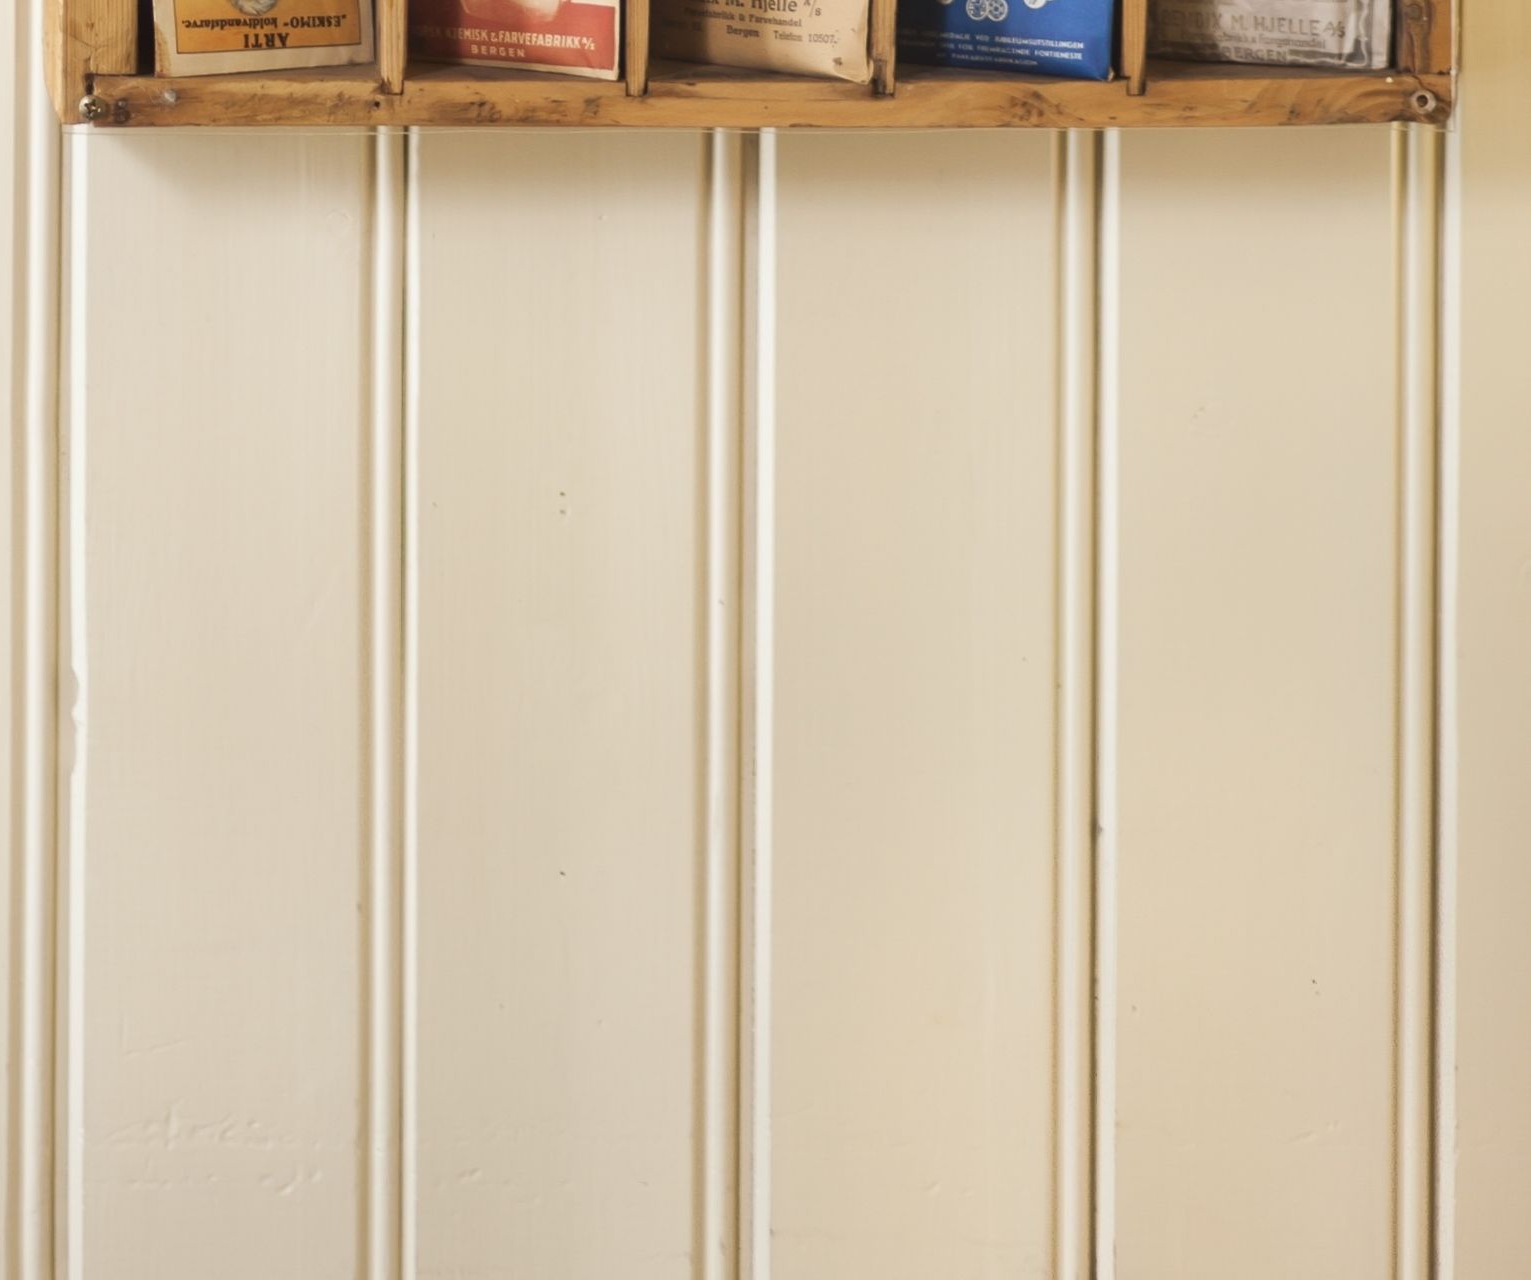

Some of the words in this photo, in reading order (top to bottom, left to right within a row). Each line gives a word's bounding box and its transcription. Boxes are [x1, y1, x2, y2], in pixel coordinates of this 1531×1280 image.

[1252, 15, 1321, 36] HJELLE
[242, 32, 290, 49] ARTI
[498, 29, 582, 49] FARVEFABRIKK
[470, 43, 526, 58] BERGEN
[1221, 45, 1287, 61] BERGEN
